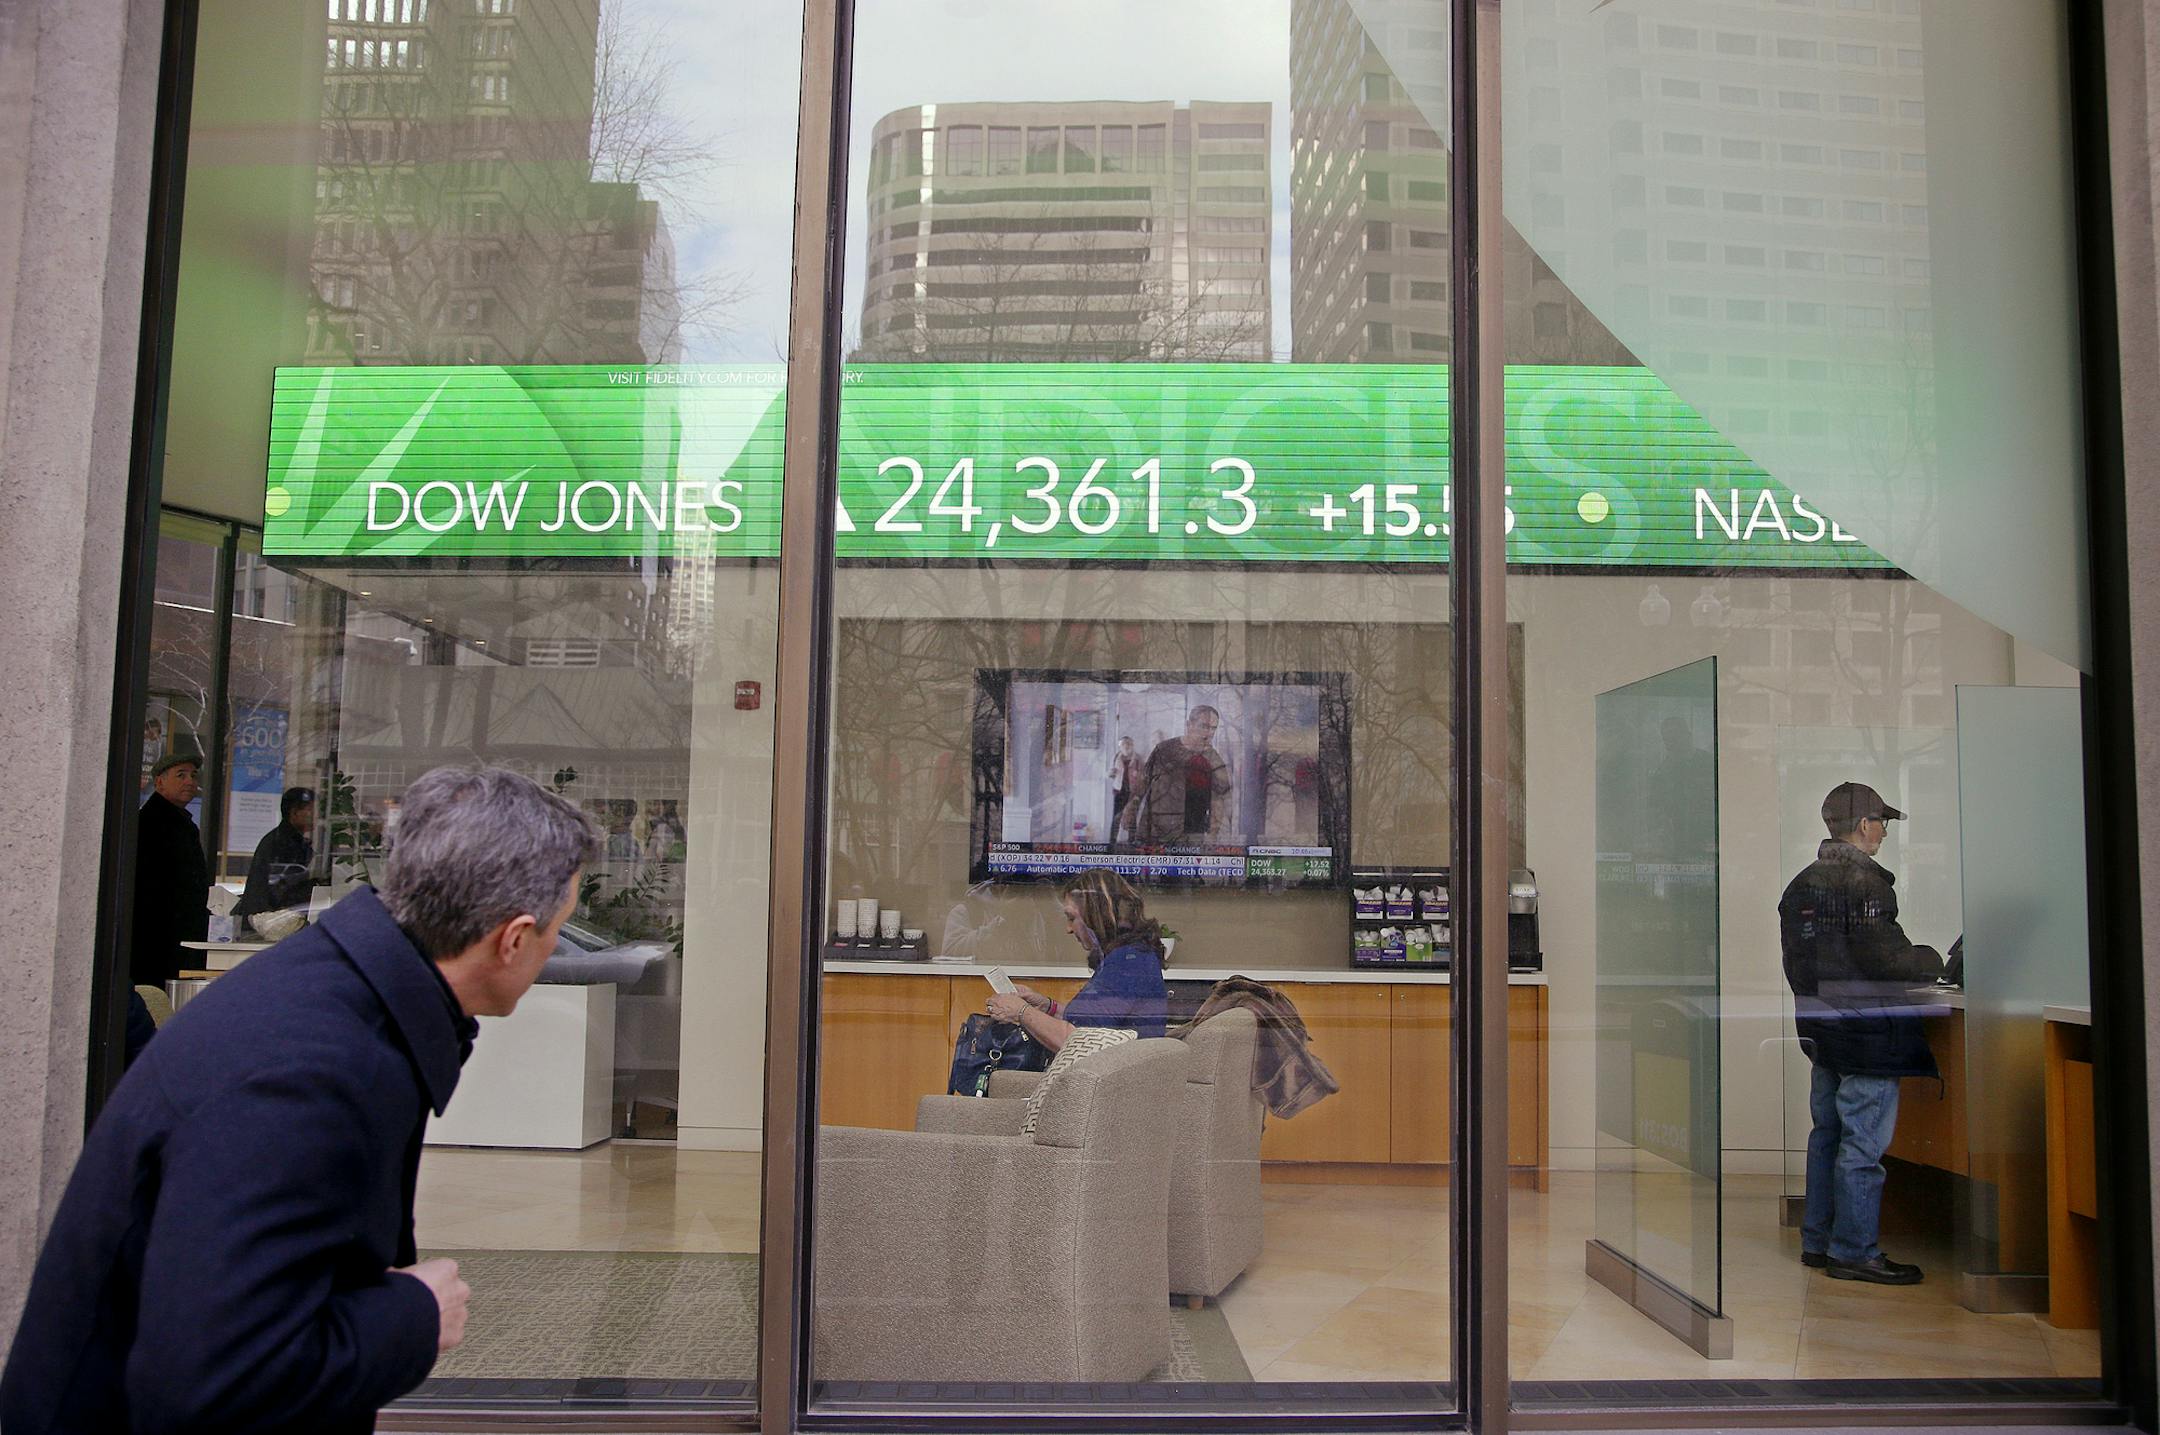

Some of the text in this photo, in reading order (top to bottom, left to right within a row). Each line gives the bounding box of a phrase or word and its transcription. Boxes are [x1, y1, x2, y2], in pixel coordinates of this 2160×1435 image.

[607, 371, 641, 384] VISIT
[645, 371, 742, 385] FIDELITY.COM
[747, 371, 779, 385] FOR
[366, 456, 1859, 548] DOW JONES 24,361.3 +15. NAS
[1007, 843, 1021, 851] 500
[1078, 843, 1108, 853] CHANGE
[997, 854, 1021, 862] (XOP)
[1080, 855, 1115, 863] Emerson
[1147, 856, 1172, 864] (EMR)
[1250, 859, 1272, 867] DOW
[1000, 864, 1017, 872] 6.76
[1026, 865, 1069, 873] Automatic
[1150, 867, 1168, 875] 2.70
[1176, 867, 1197, 875] Tech
[1197, 868, 1216, 876] Data
[1217, 868, 1244, 877] (TECD
